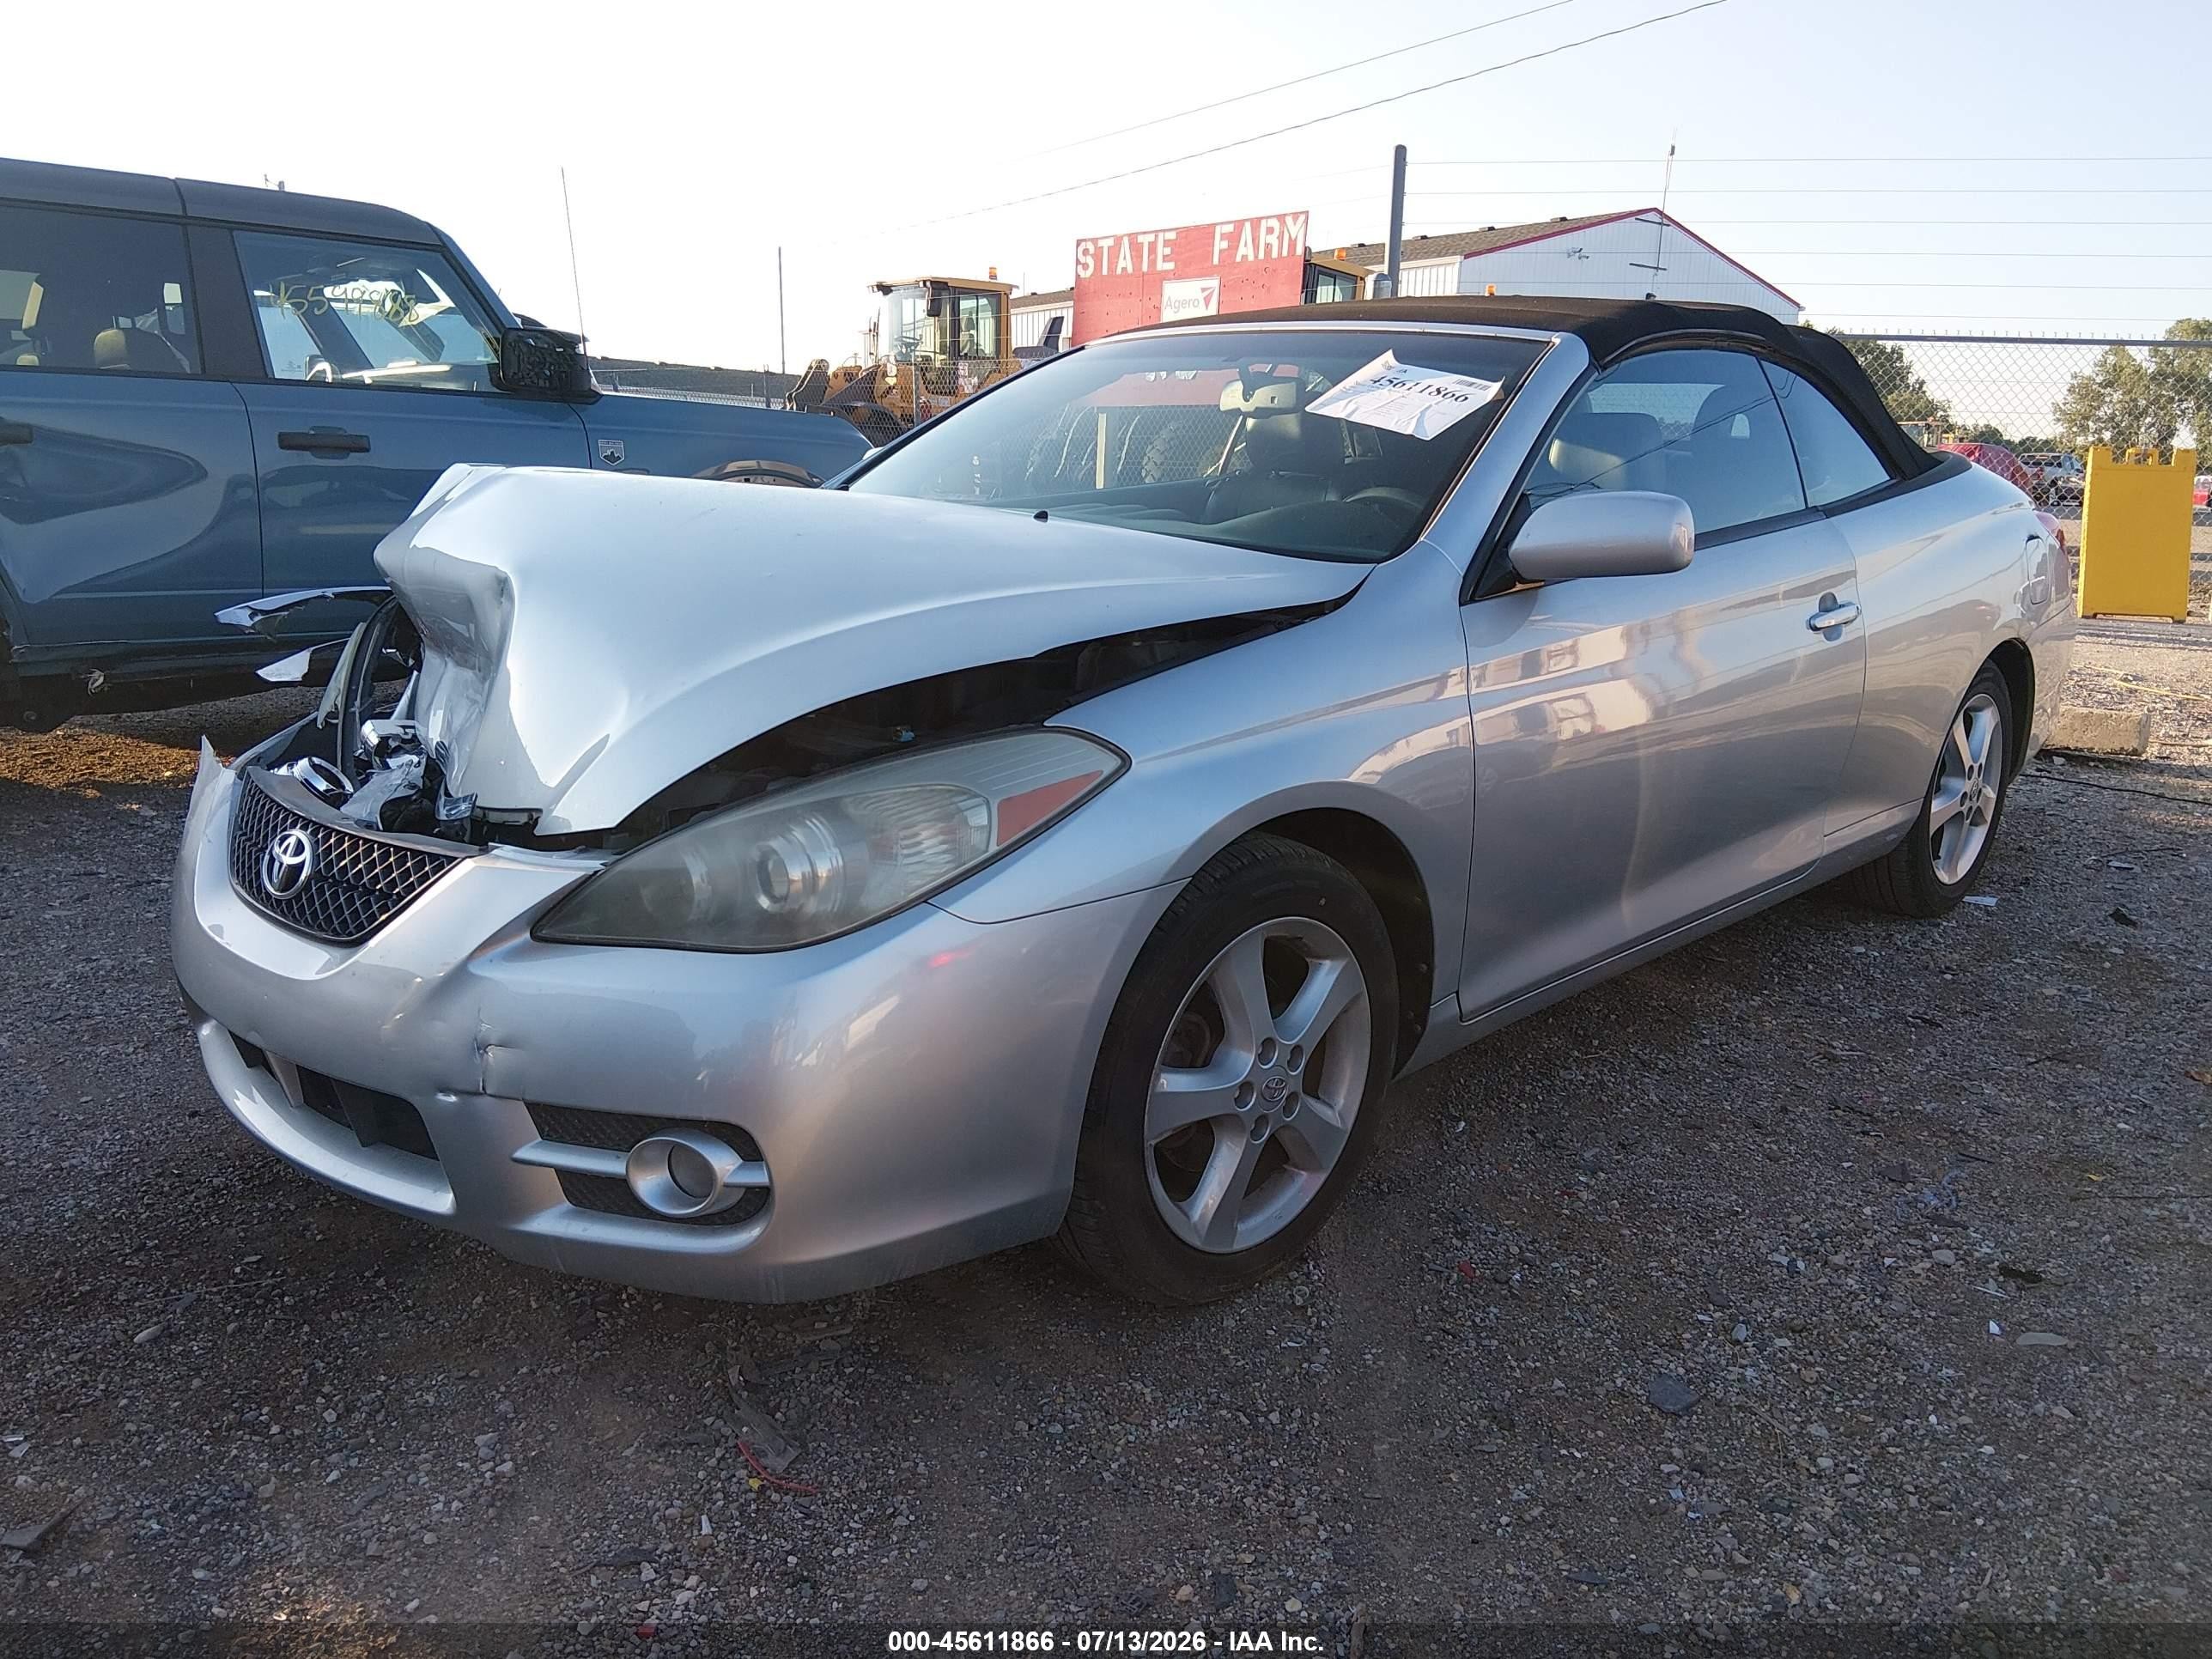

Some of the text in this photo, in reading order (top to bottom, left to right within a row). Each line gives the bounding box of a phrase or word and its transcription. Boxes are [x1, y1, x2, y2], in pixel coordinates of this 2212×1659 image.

[1076, 214, 1306, 278] STATE FARM
[1164, 295, 1200, 314] Agero
[1370, 375, 1477, 403] 45611866
